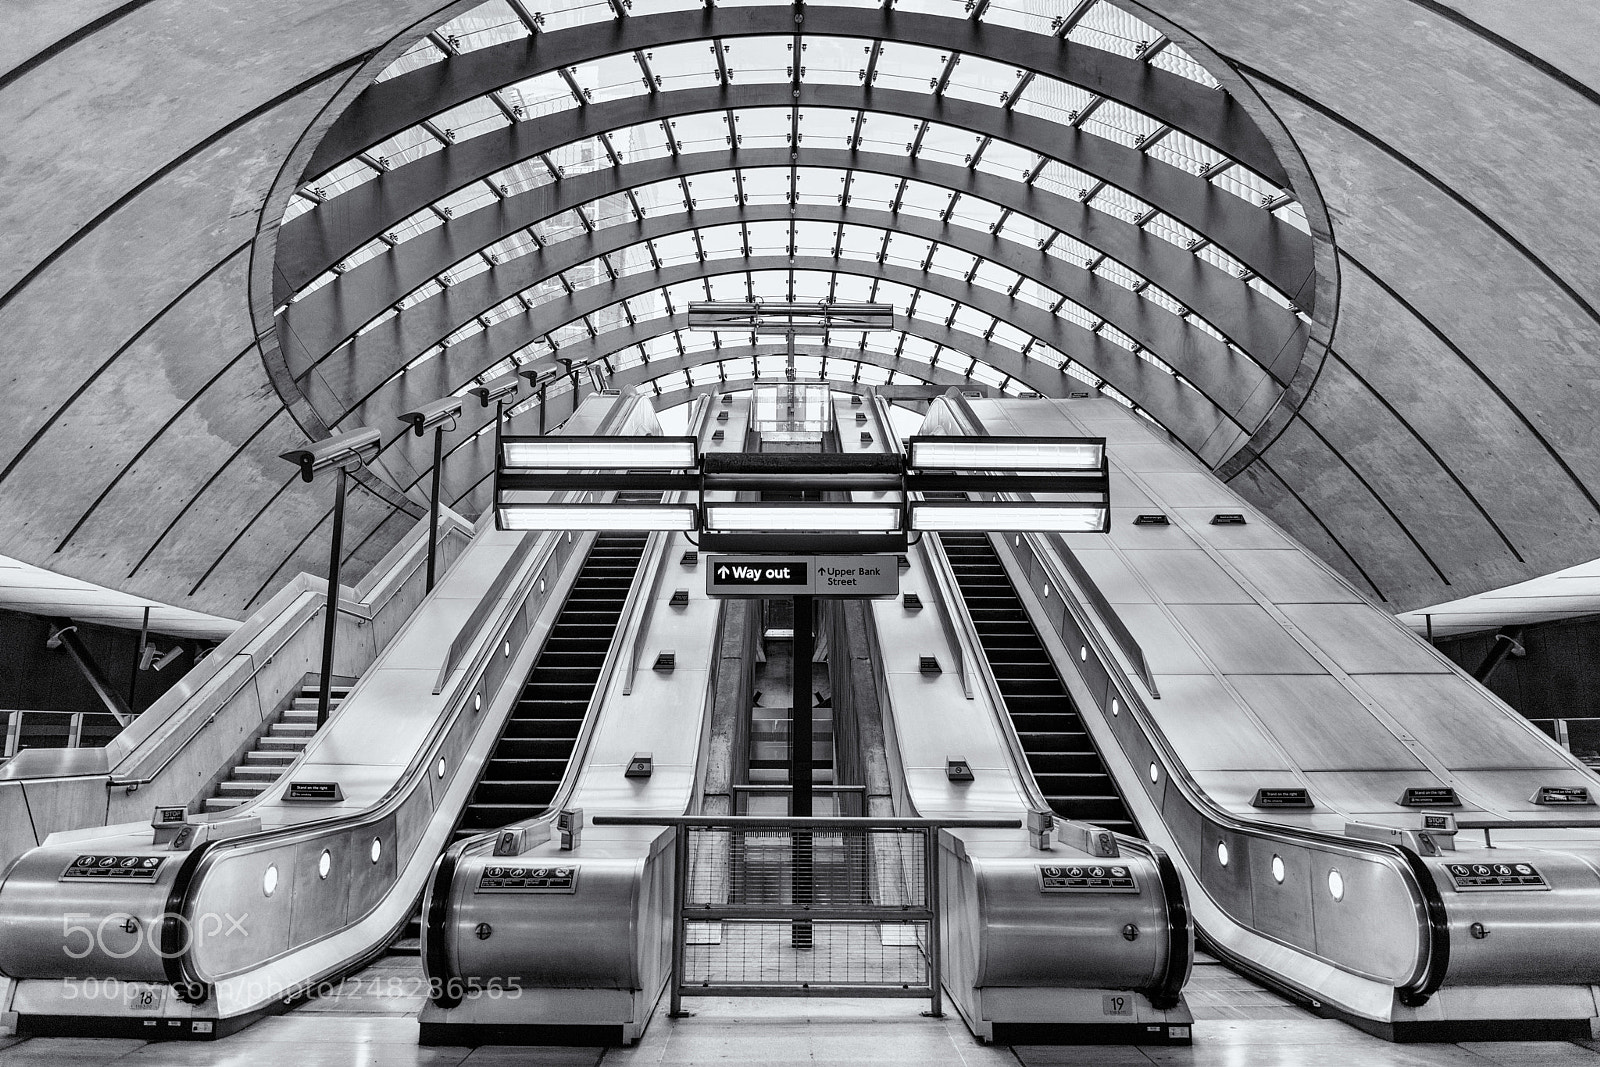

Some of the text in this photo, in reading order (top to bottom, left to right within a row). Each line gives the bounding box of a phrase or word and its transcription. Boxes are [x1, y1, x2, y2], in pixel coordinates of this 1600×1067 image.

[731, 566, 791, 581] Way out
[827, 567, 881, 578] Upper Bank
[827, 577, 857, 586] Street
[140, 991, 153, 1005] 18
[1110, 997, 1125, 1011] 19
